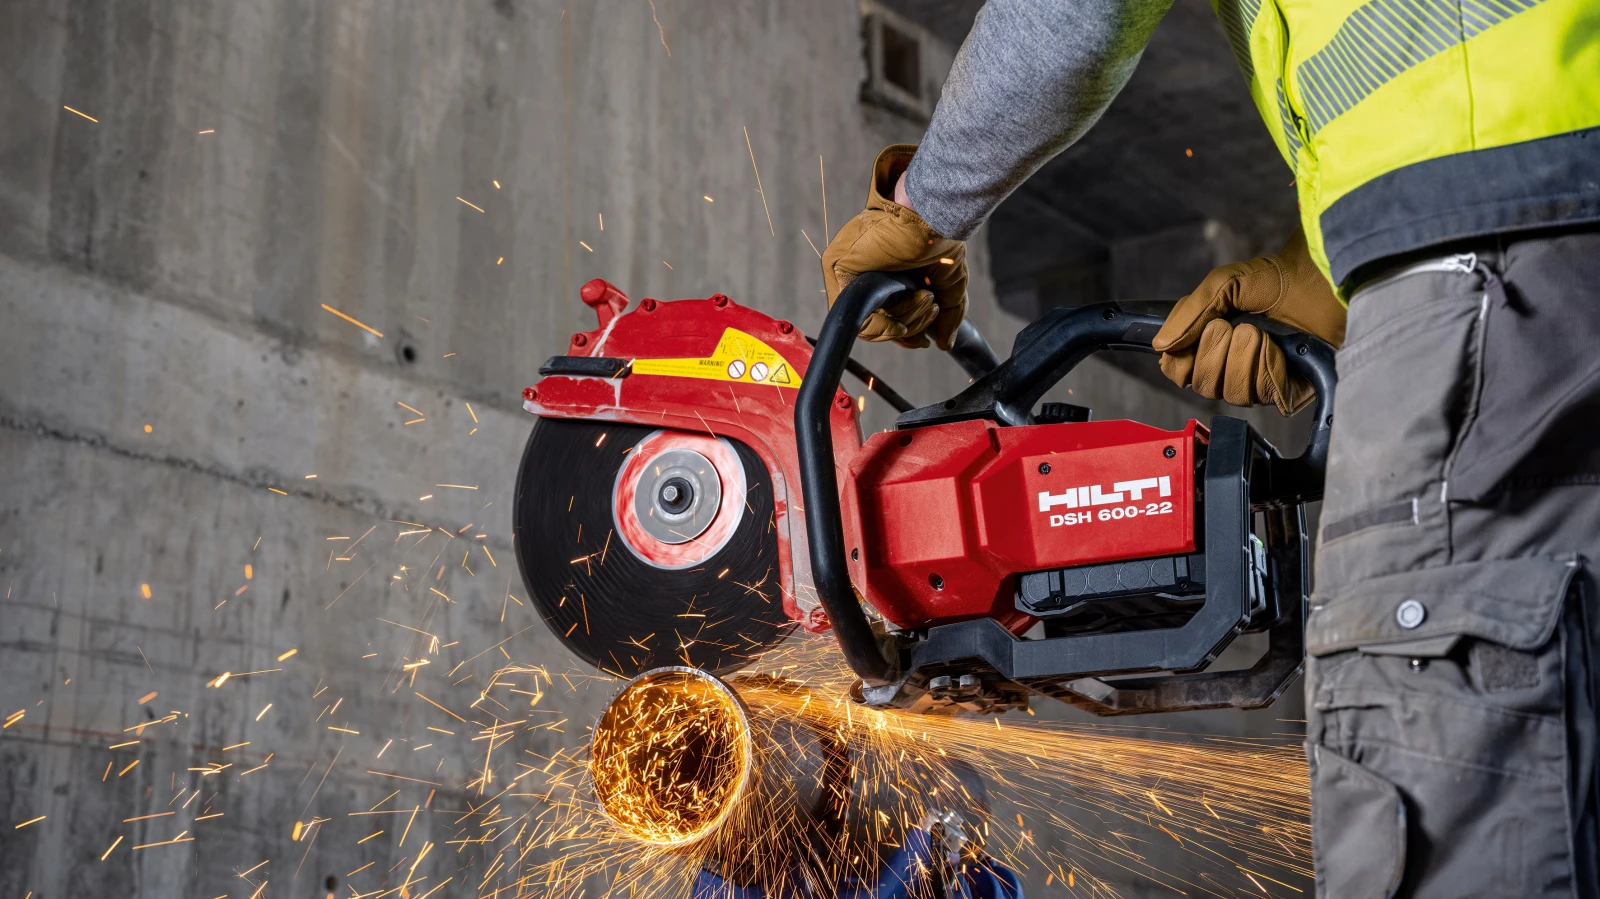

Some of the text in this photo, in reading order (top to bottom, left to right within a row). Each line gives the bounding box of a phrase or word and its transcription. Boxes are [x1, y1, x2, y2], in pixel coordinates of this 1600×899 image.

[1038, 475, 1171, 512] HILTI
[1050, 501, 1173, 527] DSH 600-22
